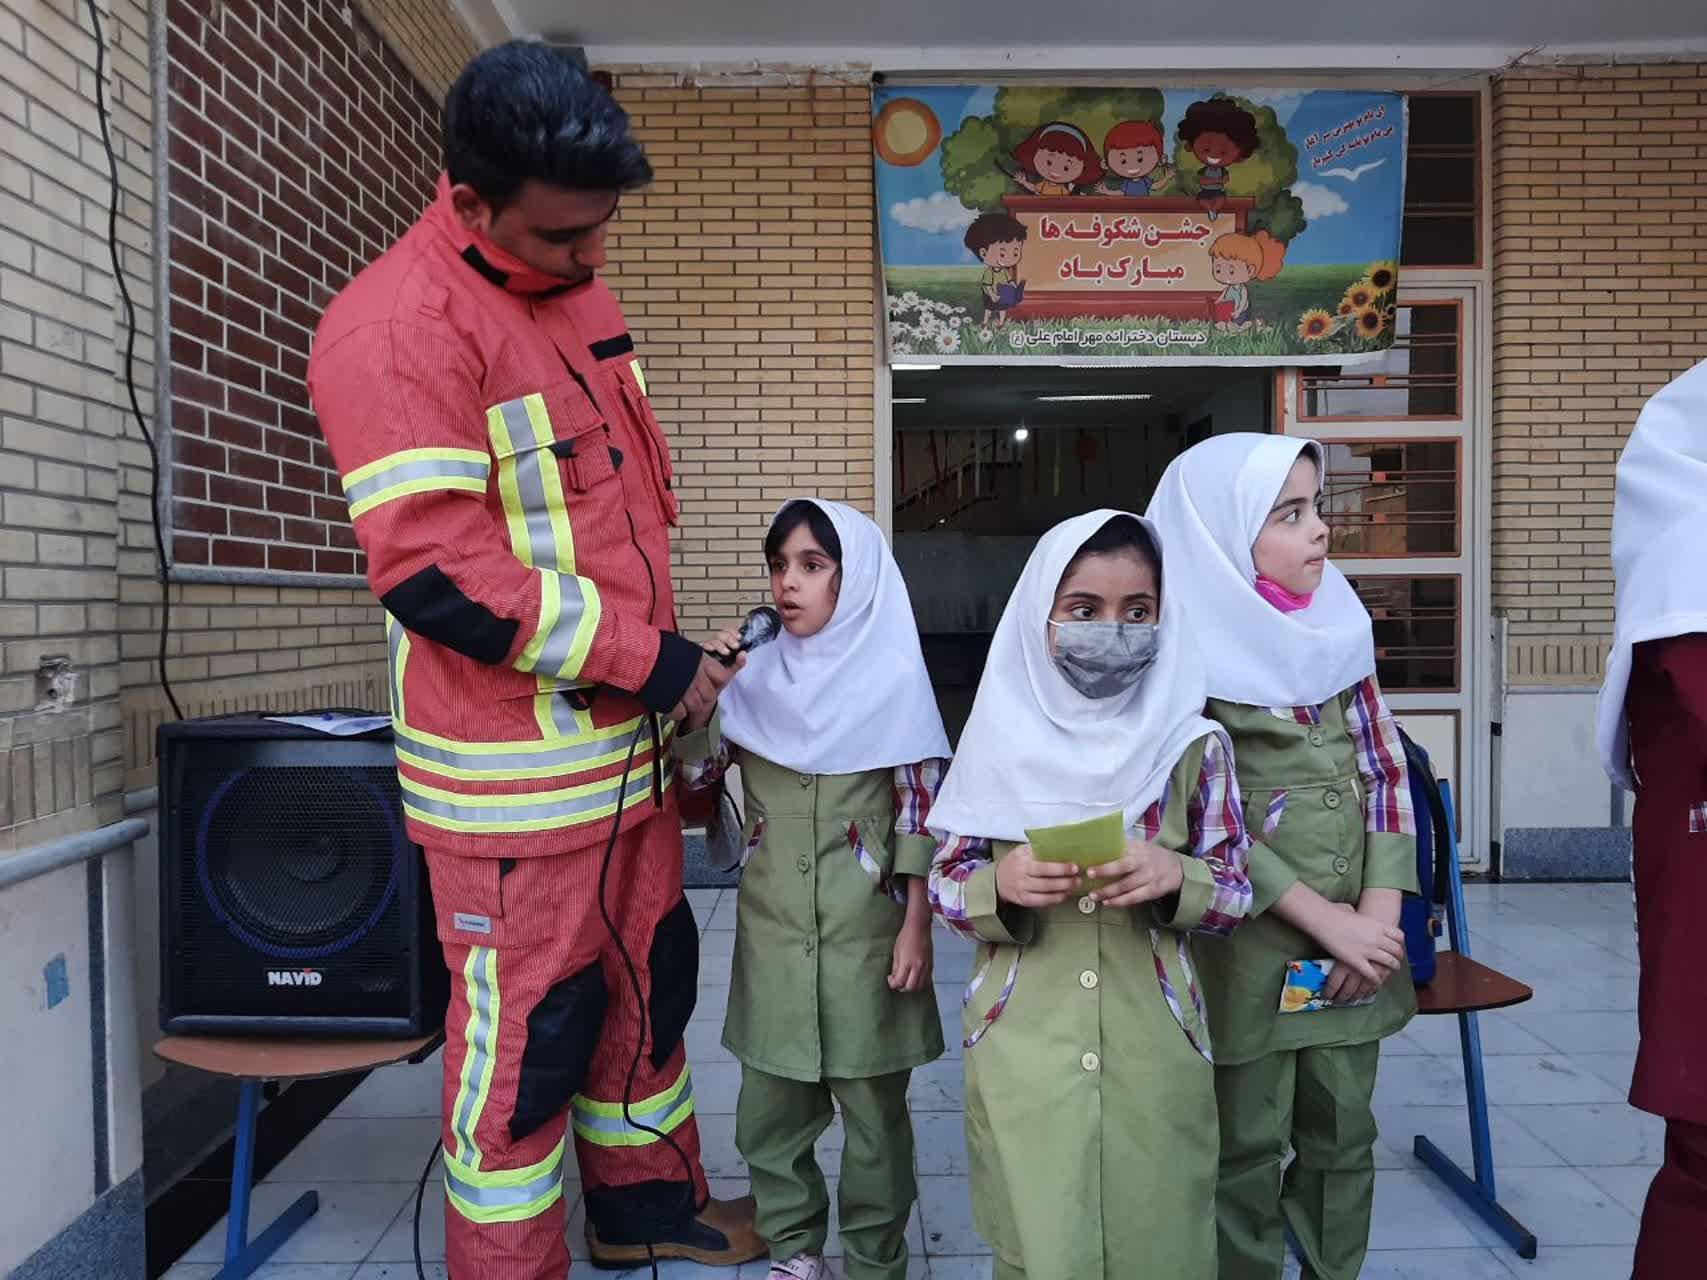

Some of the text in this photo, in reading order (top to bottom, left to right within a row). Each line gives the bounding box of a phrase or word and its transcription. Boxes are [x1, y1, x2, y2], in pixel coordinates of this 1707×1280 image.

[1040, 216, 1211, 247] جشن شکوفه ها
[1060, 256, 1185, 286] مبارک باد
[1027, 330, 1051, 347] علی
[1053, 330, 1078, 347] امام
[1079, 331, 1104, 347] مهر
[1105, 330, 1154, 347] دخترانه
[1156, 330, 1206, 348] دبستان
